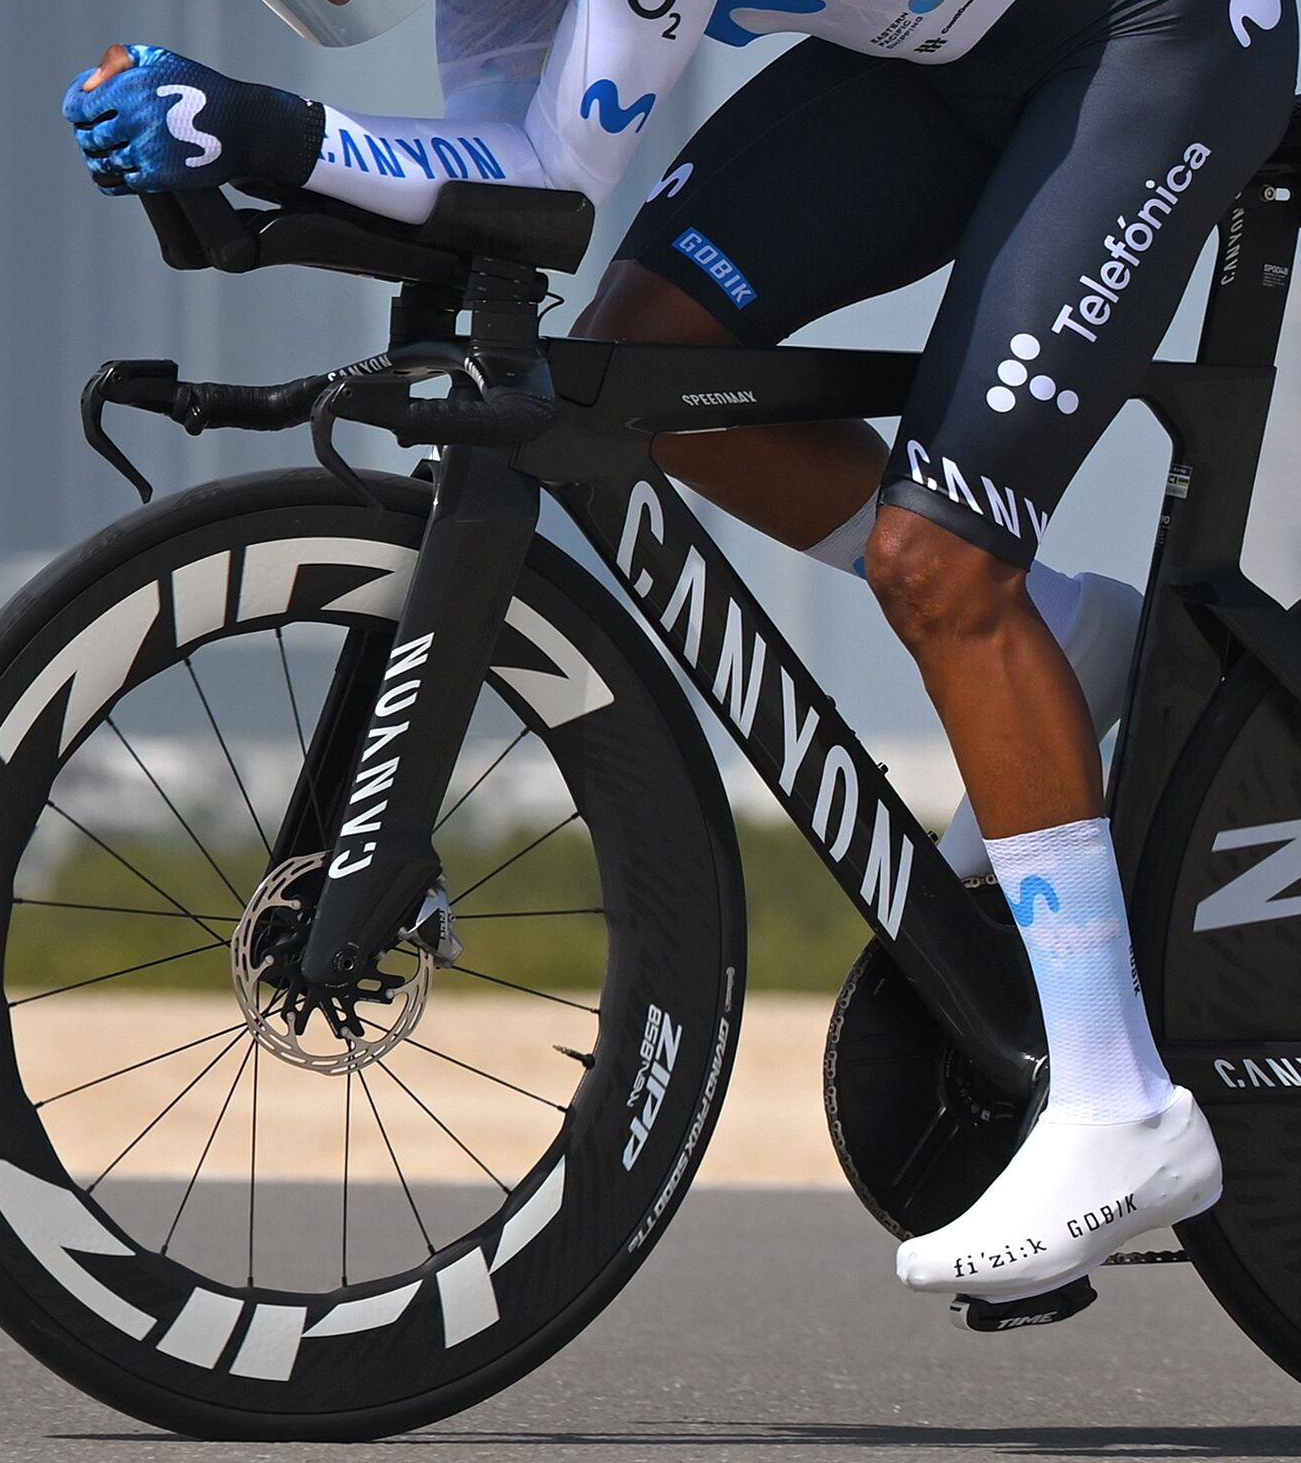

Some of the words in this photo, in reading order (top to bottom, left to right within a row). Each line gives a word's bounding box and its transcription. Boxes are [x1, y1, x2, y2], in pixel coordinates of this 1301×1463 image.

[878, 19, 912, 47] PACIFIC
[319, 128, 506, 179] ANYON
[679, 233, 752, 303] GOBIK
[1052, 142, 1212, 342] Telefónica
[1221, 207, 1245, 286] CANYON
[328, 354, 394, 382] CANYON
[682, 390, 757, 407] SPEEDMAX
[907, 439, 1049, 540] CANY
[616, 480, 915, 941] CANYON
[328, 632, 435, 879] CANYON
[622, 1012, 683, 1172] ZIPP
[705, 1017, 729, 1101] GRAND
[688, 1100, 711, 1158] PRIX
[1067, 1193, 1138, 1238] GOBIK
[998, 1311, 1059, 1329] TIME
